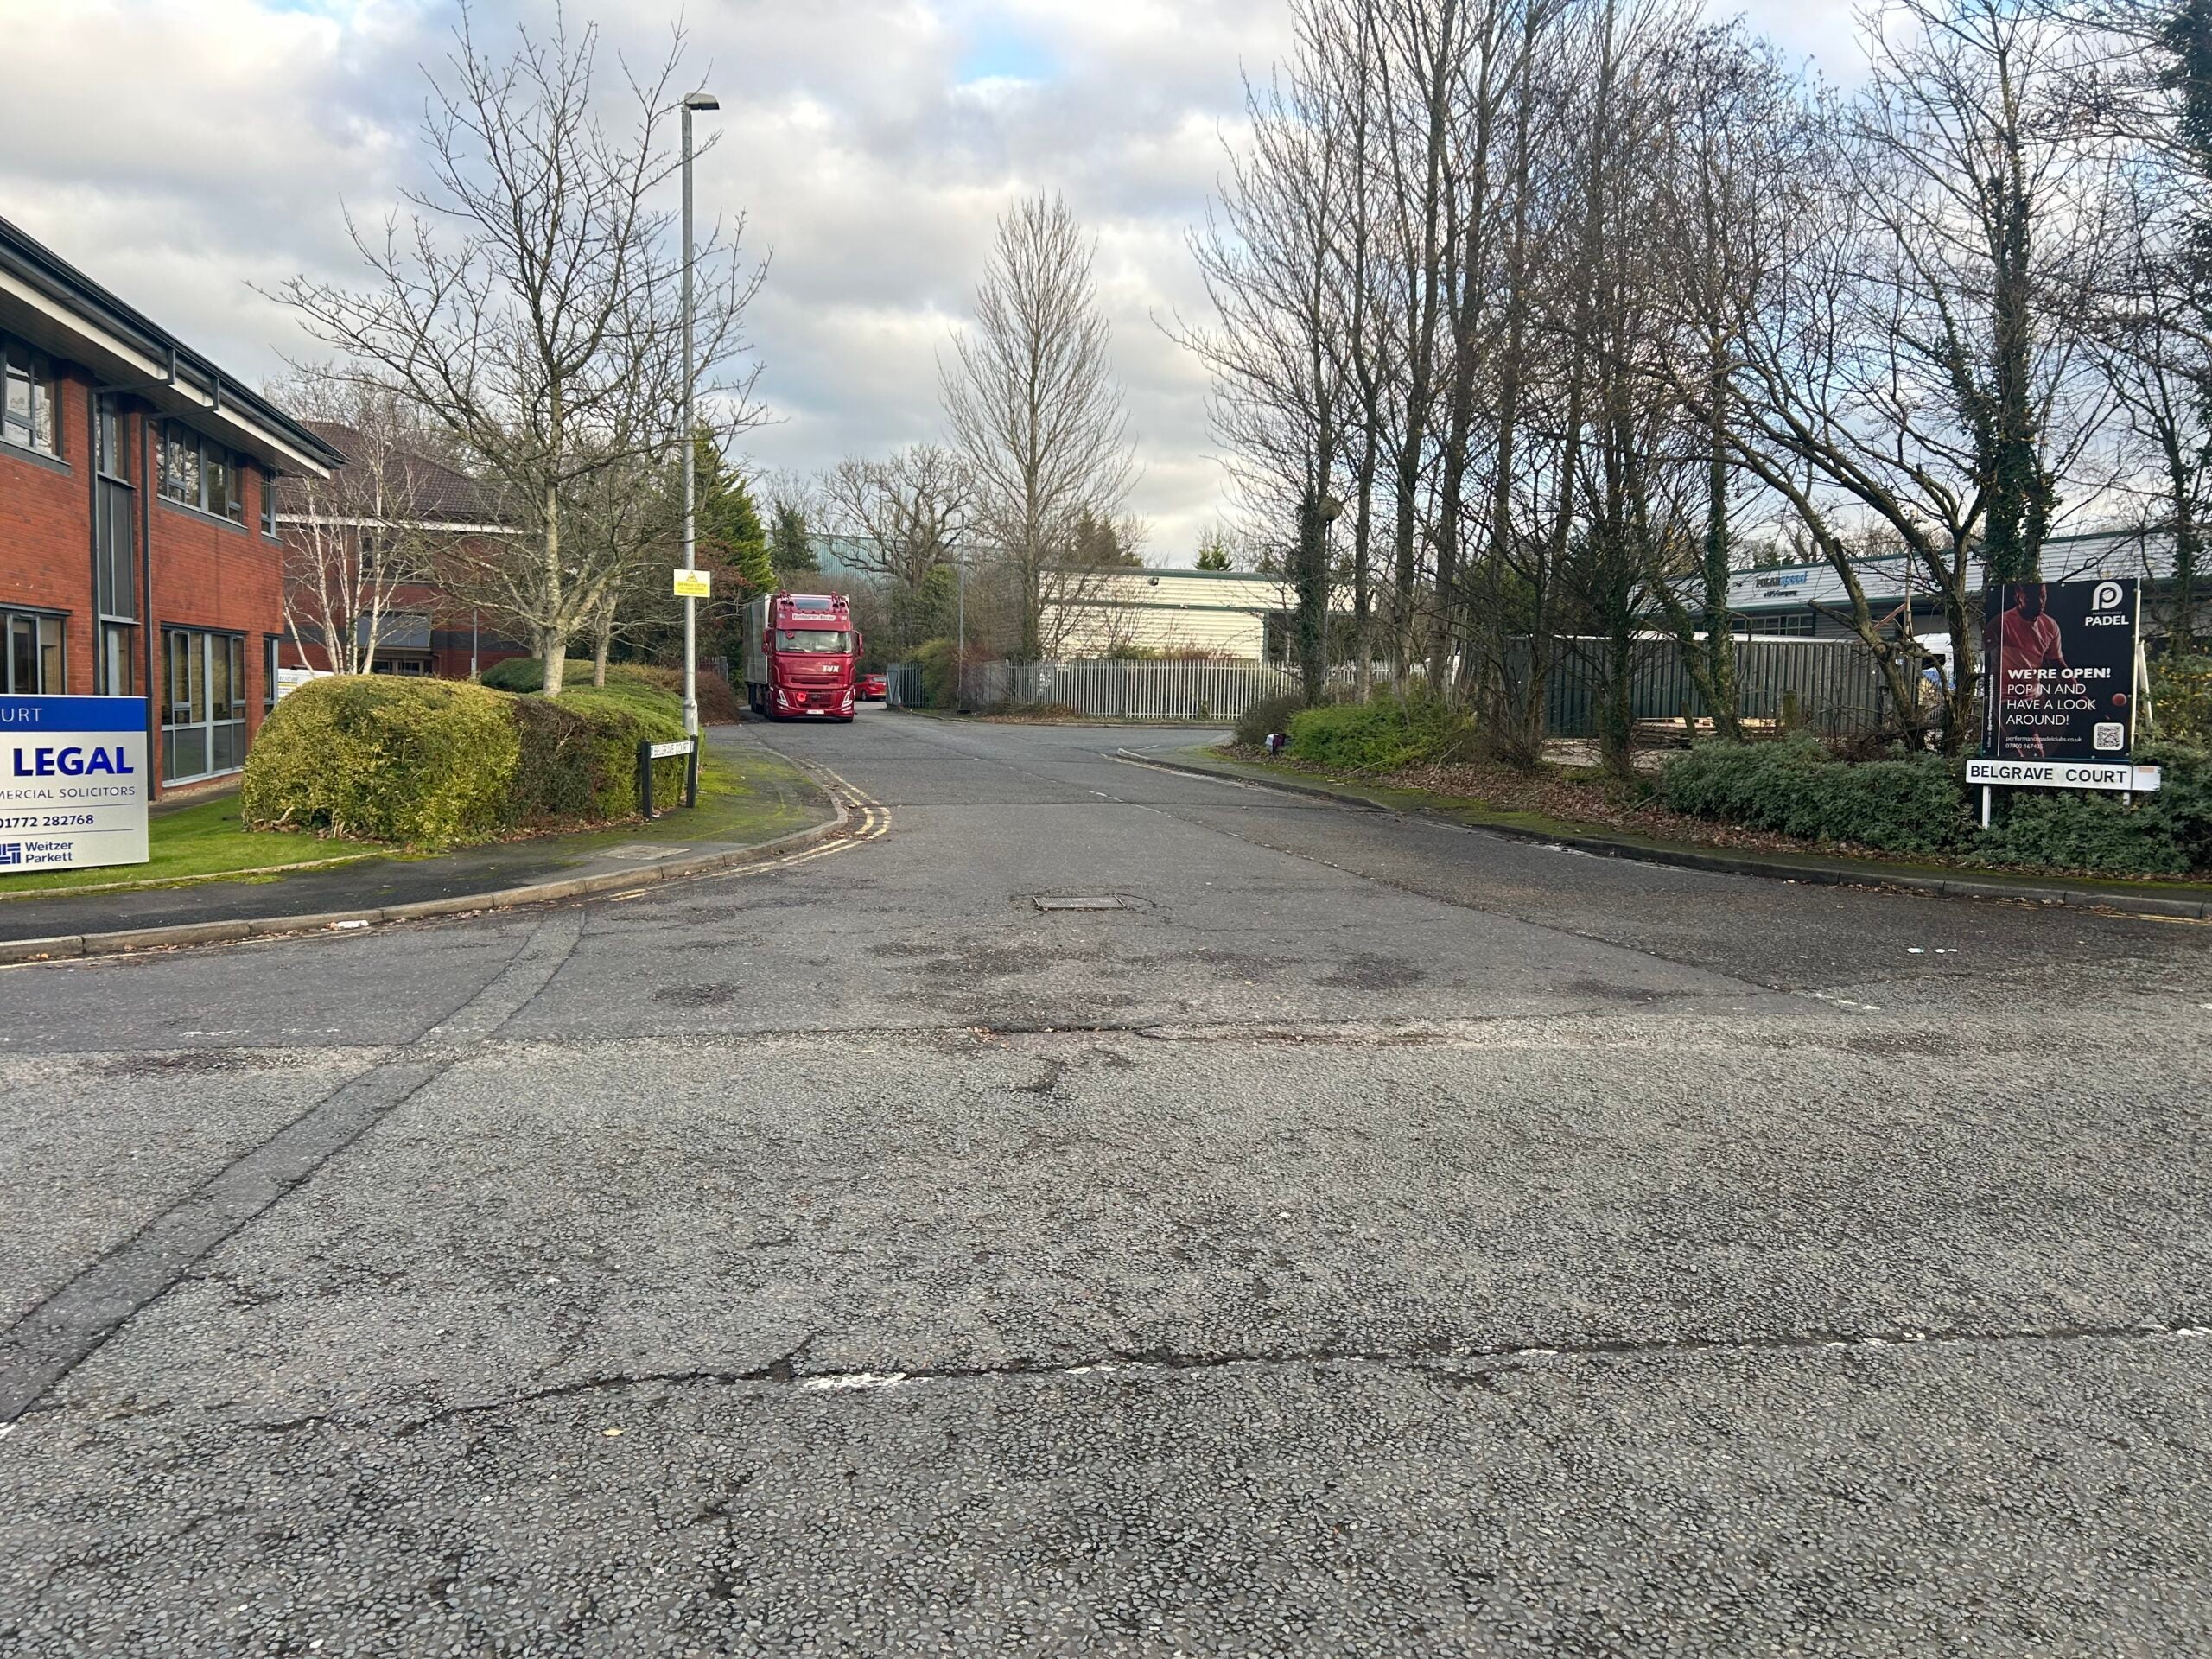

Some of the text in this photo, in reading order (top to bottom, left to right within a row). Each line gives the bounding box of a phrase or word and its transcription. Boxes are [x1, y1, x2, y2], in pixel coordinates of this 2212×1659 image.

[2084, 614, 2130, 626] PADEL
[823, 664, 839, 673] TVX
[2007, 667, 2112, 679] WE'RE OPEN!
[2007, 683, 2087, 695] POP IN AND
[2006, 699, 2097, 710] HAVE A LOOK
[2005, 715, 2069, 726] AROUND!
[13, 747, 135, 777] LEGAL
[1970, 765, 2054, 780] BELGRAVE
[2065, 769, 2127, 784] COURT
[60, 786, 136, 798] SOLICITORS
[42, 814, 94, 827] 282768
[25, 841, 74, 852] Weitzer
[25, 851, 73, 864] Parkett
